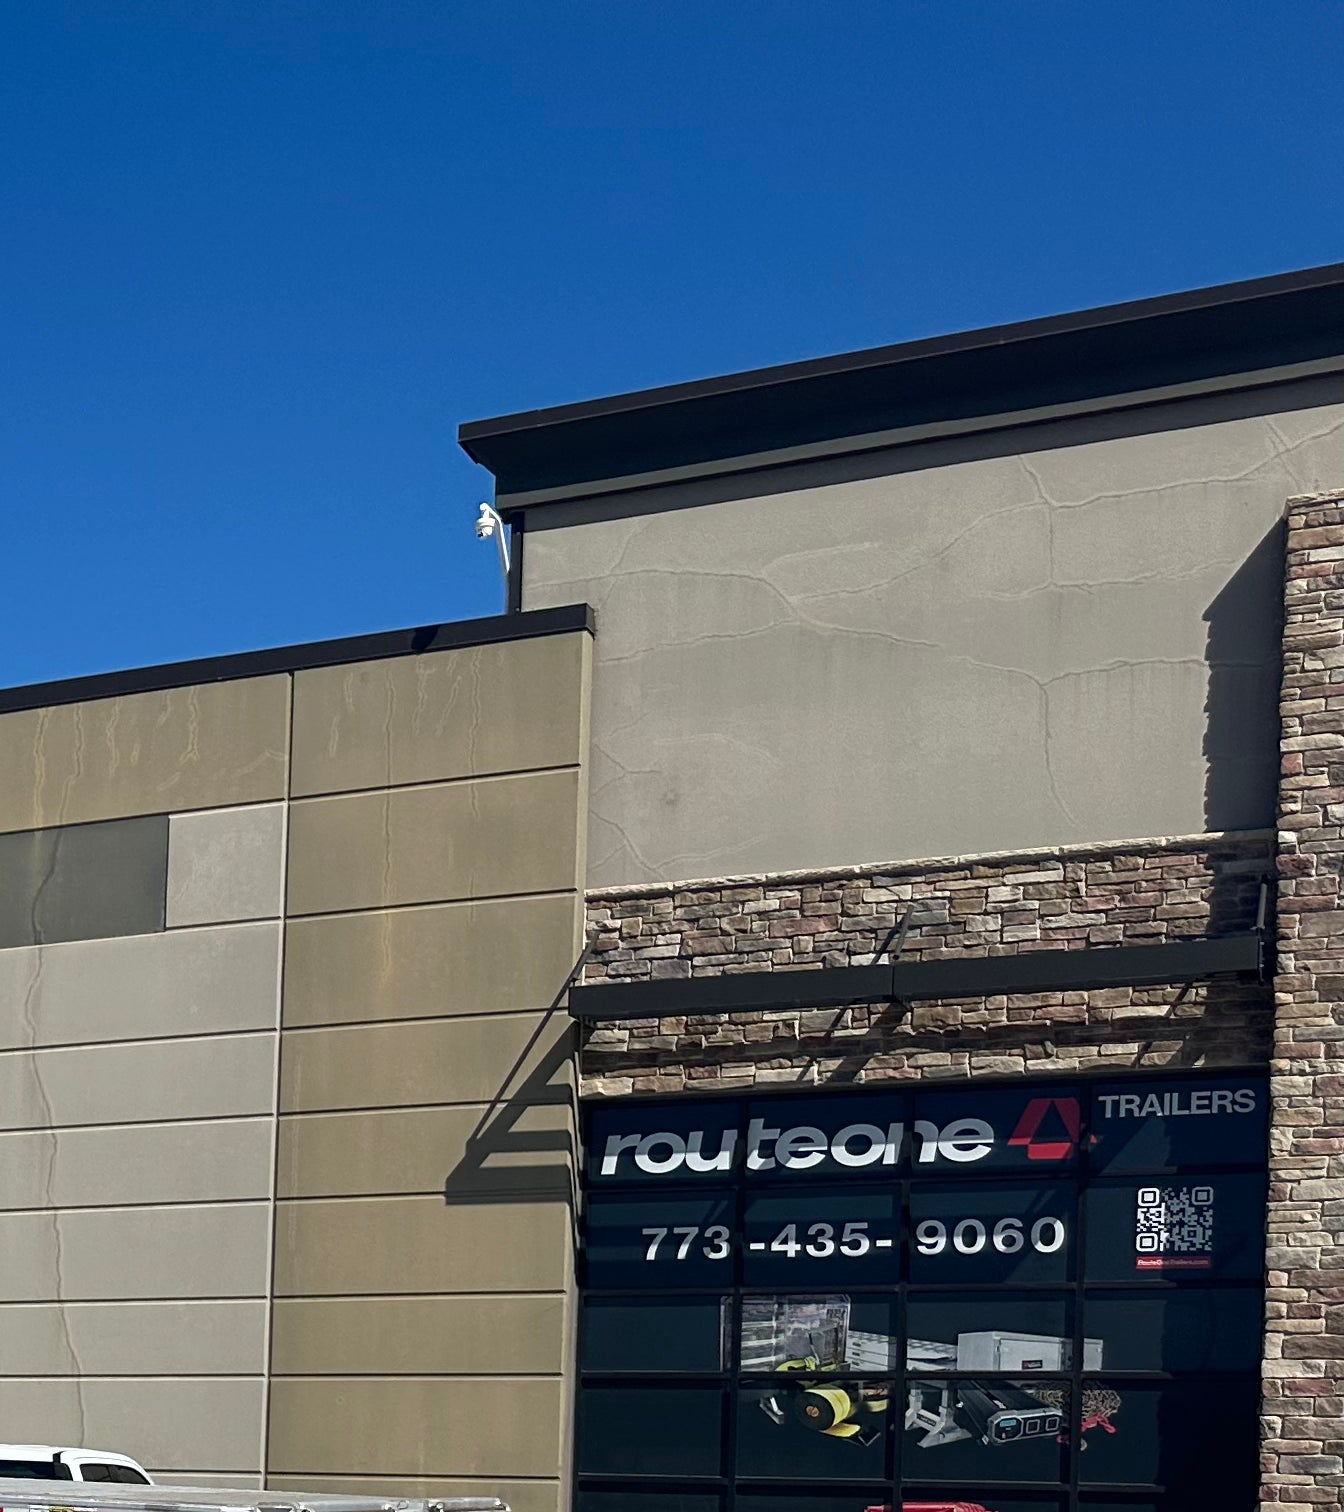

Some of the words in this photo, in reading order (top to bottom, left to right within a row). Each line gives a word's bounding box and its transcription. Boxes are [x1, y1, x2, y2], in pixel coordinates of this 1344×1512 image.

[1098, 1089, 1256, 1119] TRAILERS
[600, 1117, 995, 1176] routeone
[641, 1225, 731, 1261] 773
[915, 1215, 1066, 1256] 9060
